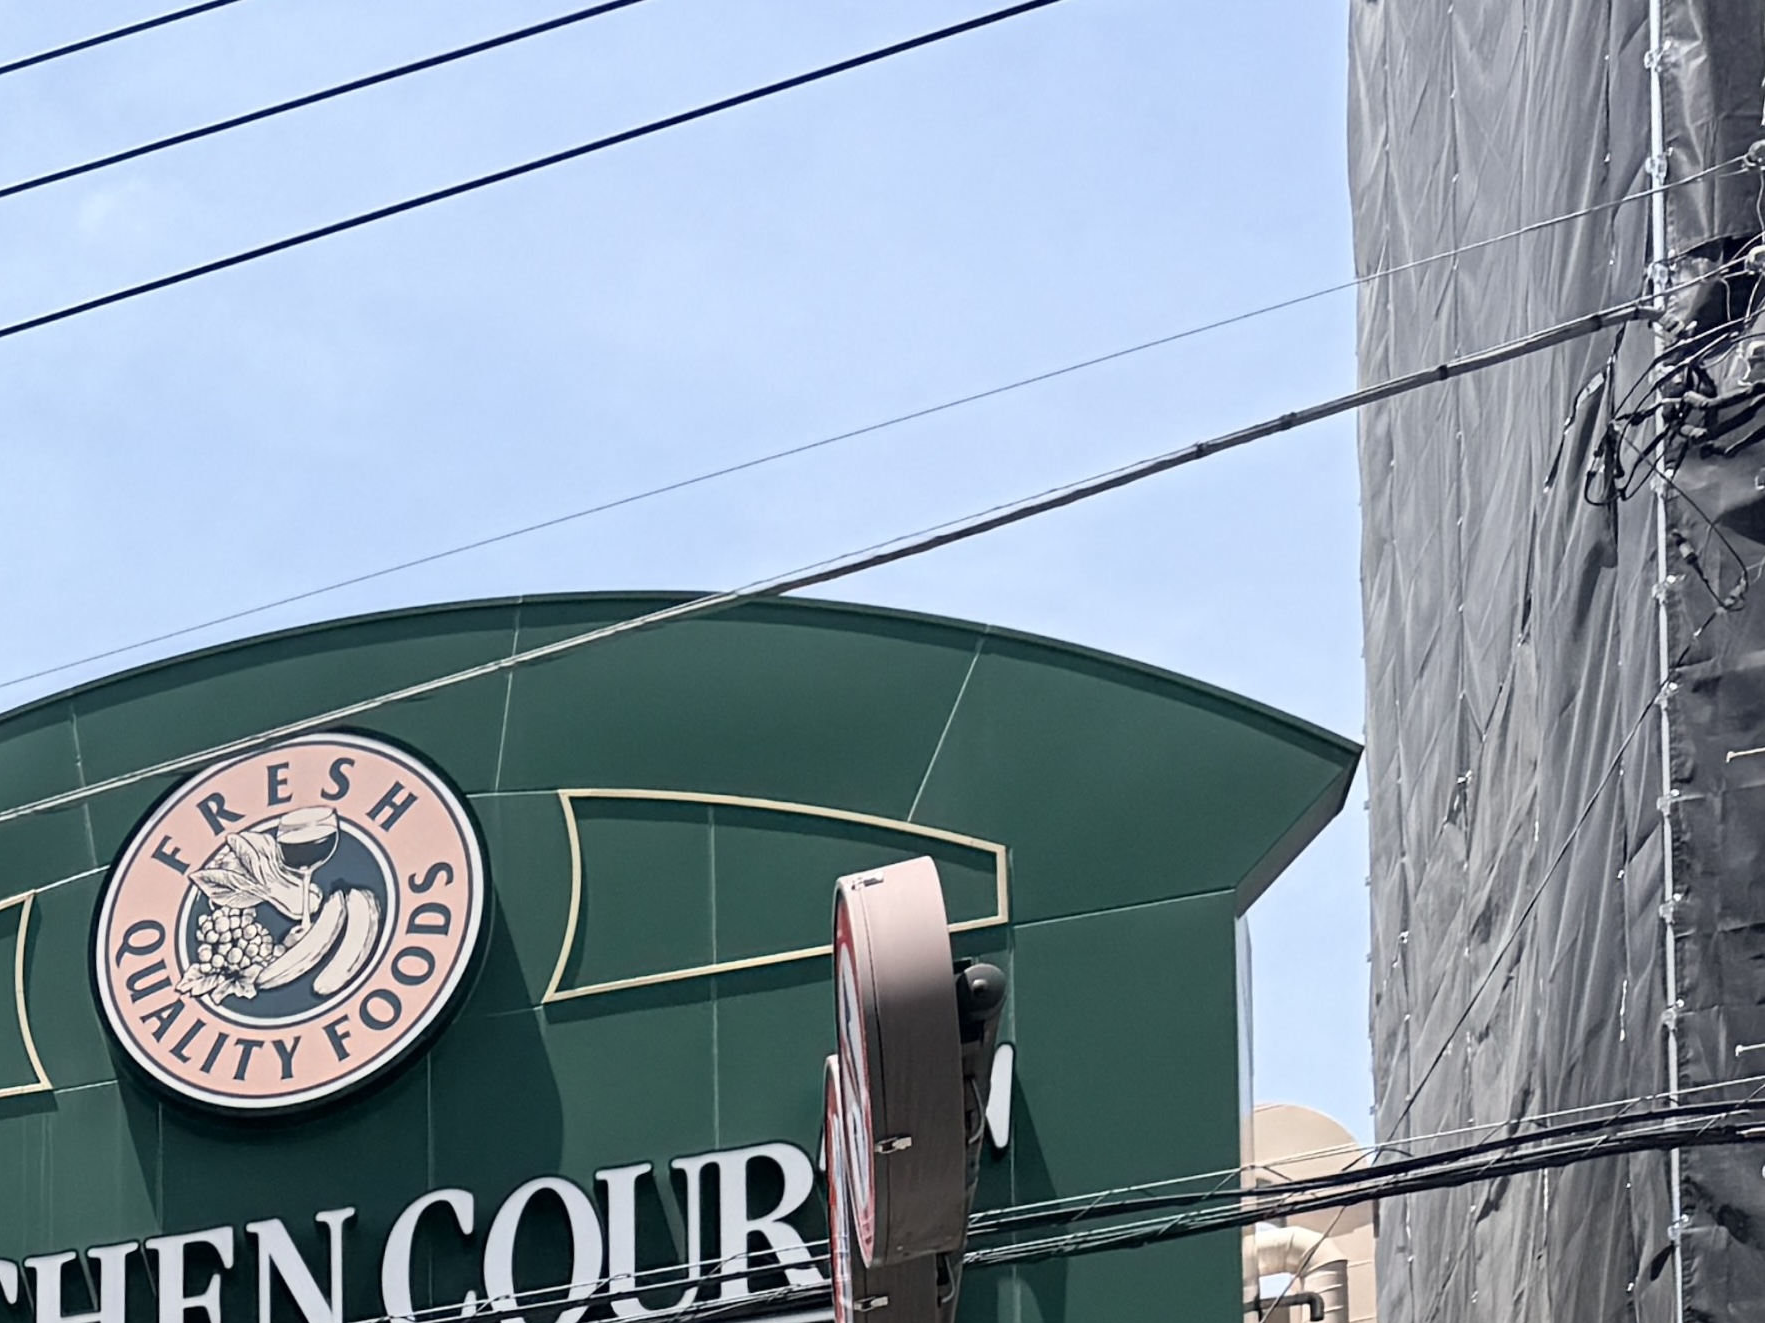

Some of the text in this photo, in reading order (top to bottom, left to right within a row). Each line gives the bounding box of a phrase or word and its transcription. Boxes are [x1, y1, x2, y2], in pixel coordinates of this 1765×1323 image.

[151, 757, 418, 876] FRESH
[116, 861, 454, 1082] QUALITY FOODS
